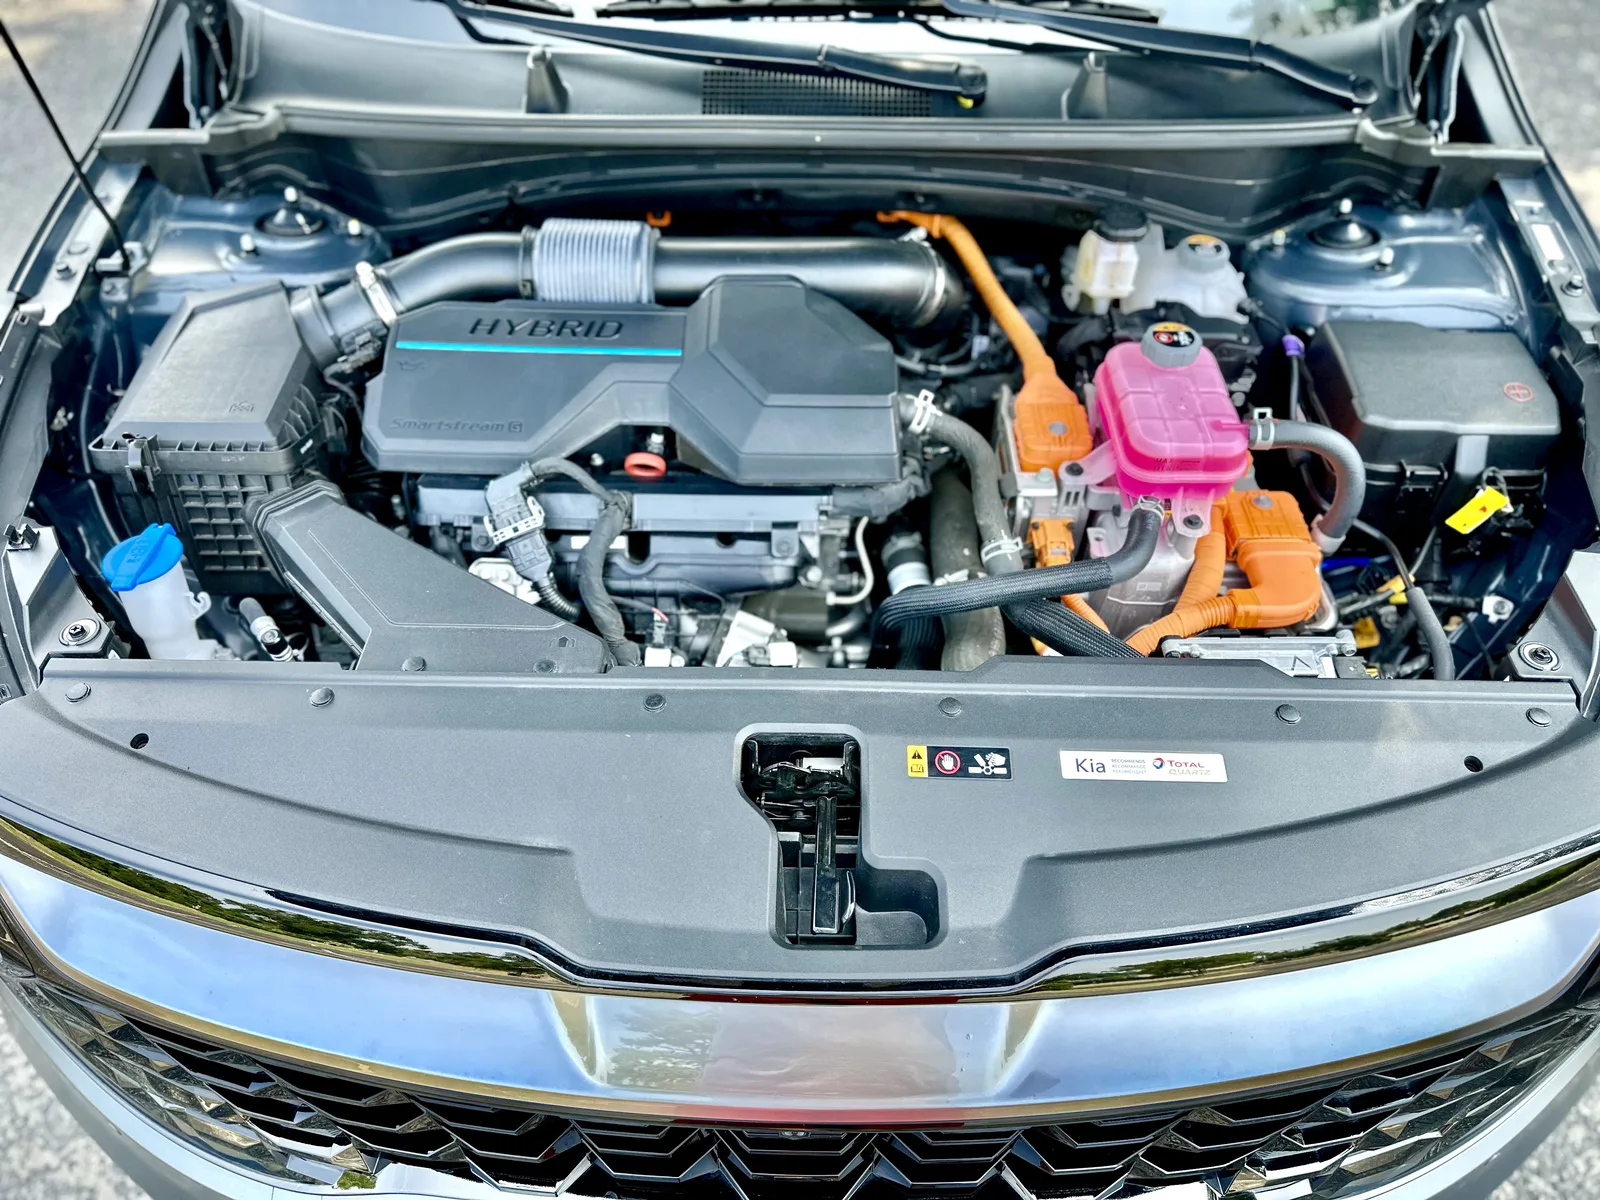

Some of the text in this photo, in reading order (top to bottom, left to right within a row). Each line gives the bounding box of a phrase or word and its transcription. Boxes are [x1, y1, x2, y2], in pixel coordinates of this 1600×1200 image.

[469, 317, 624, 340] HYBRID
[390, 417, 505, 432] Smartstream
[1075, 758, 1106, 774] Kia
[1167, 759, 1205, 769] TOTAL
[1169, 768, 1212, 776] QUARTZ
